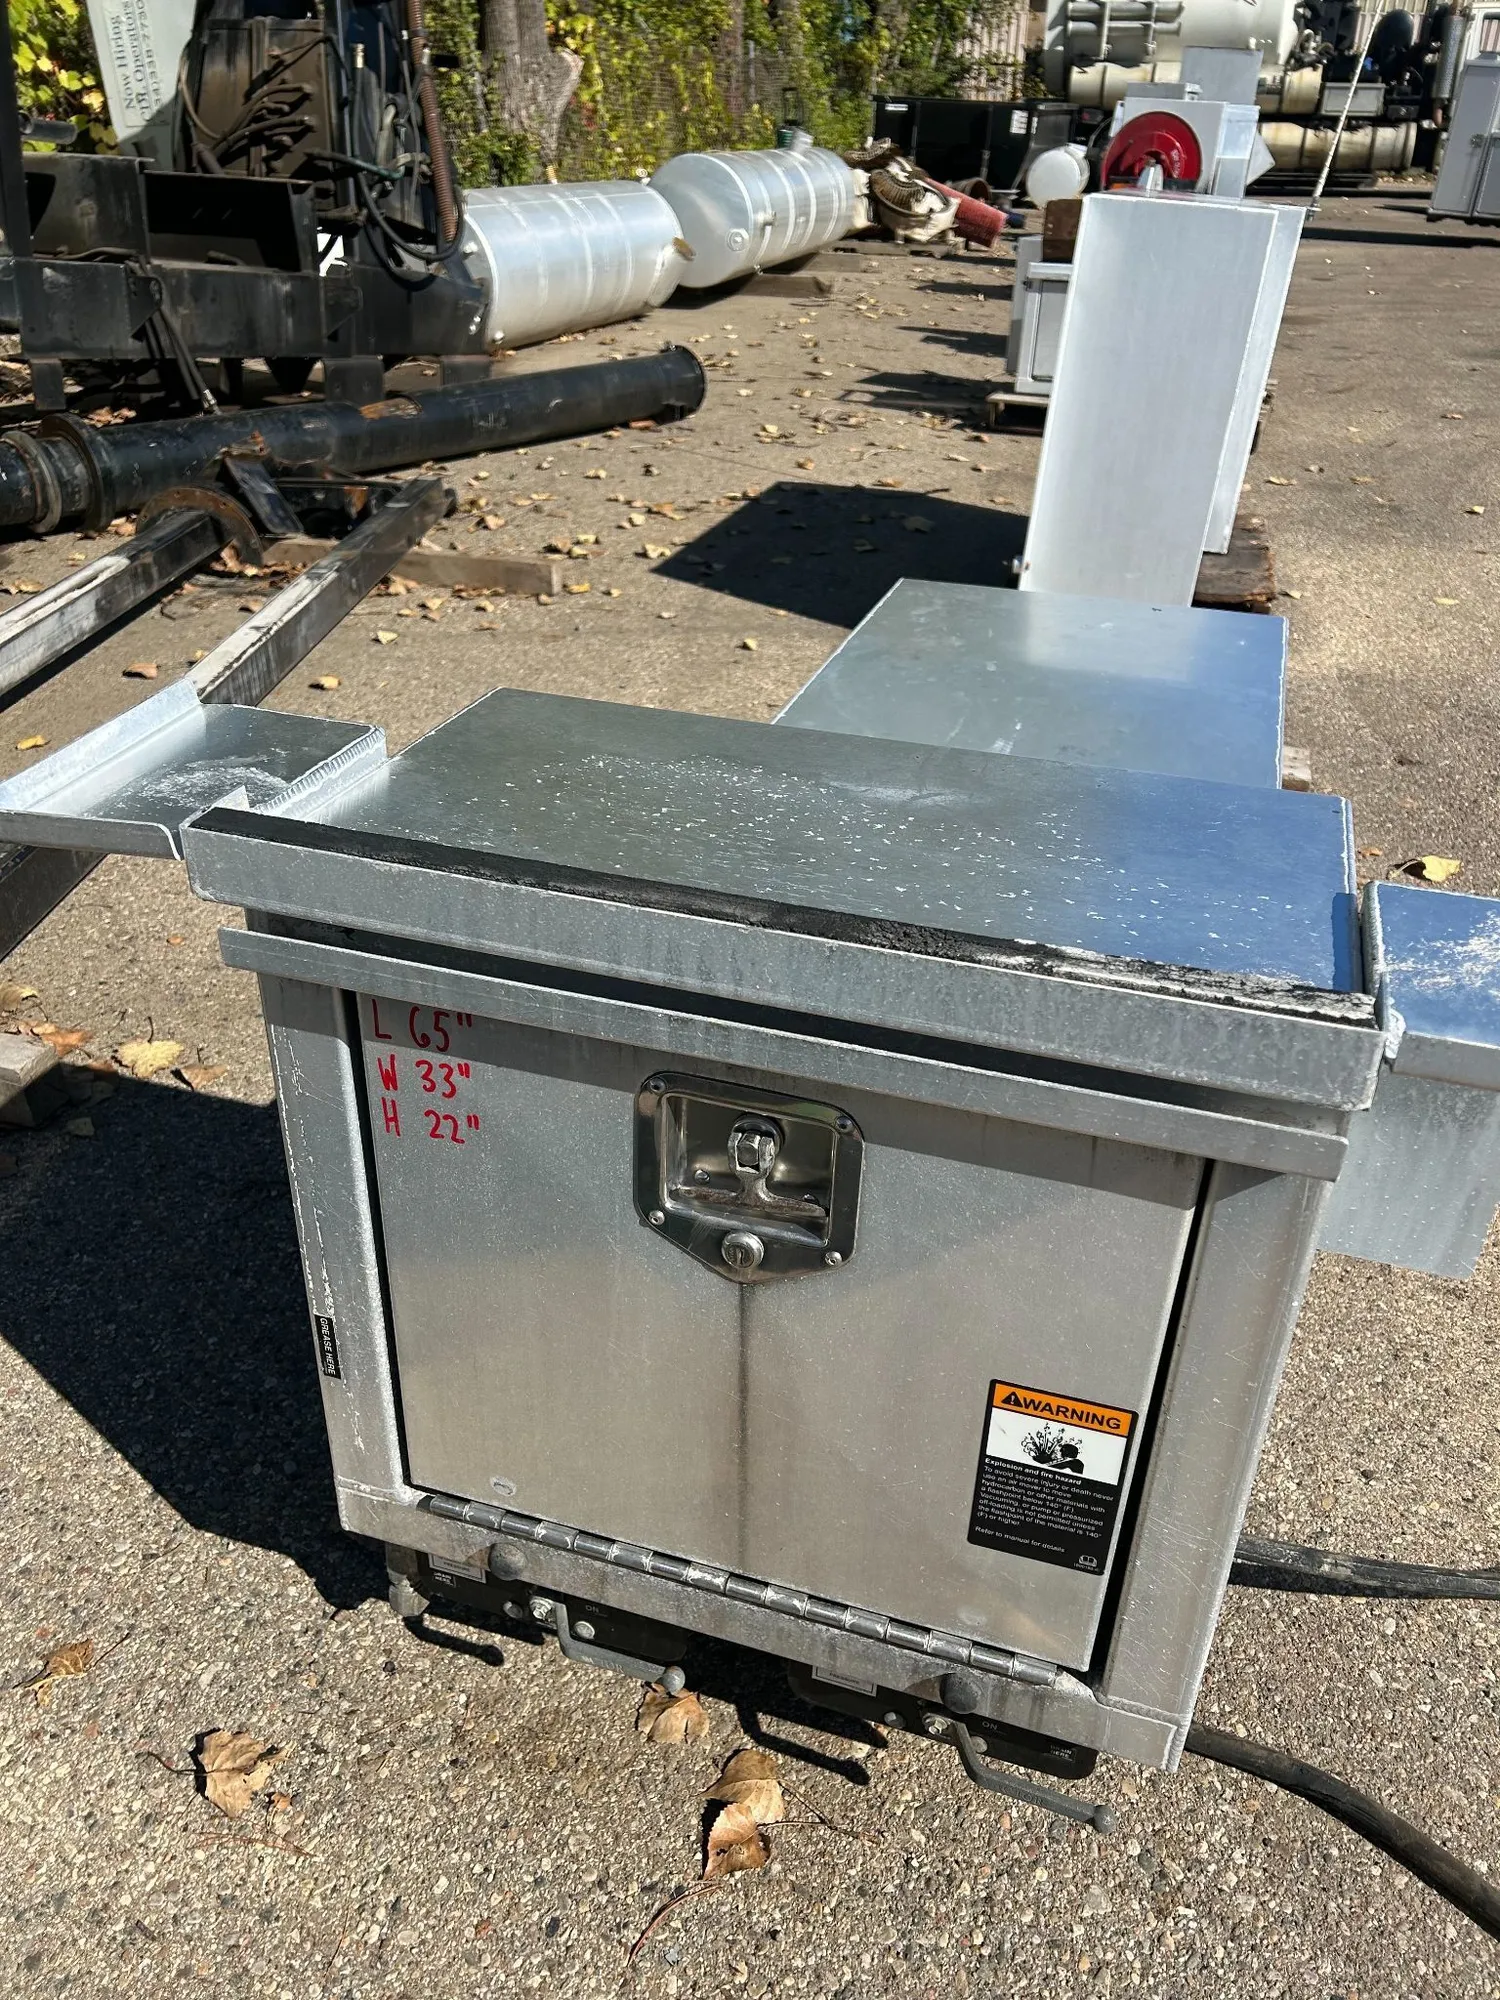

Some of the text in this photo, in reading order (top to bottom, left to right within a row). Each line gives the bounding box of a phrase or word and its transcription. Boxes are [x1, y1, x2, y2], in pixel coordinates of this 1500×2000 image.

[122, 74, 136, 109] Now
[371, 998, 473, 1053] L 65"
[377, 1054, 471, 1099] W 33"
[381, 1097, 480, 1144] H 22"
[320, 1317, 335, 1375] GREASE HERE
[1021, 1397, 1120, 1428] WARNING
[984, 1457, 1022, 1471] Explosion
[1055, 1474, 1081, 1485] hazard
[994, 1469, 1013, 1477] avoid
[1015, 1474, 1038, 1483] severe
[1070, 1487, 1091, 1495] death
[1022, 1495, 1043, 1505] below
[1030, 1505, 1051, 1514] pump
[1035, 1492, 1054, 1500] other
[975, 1526, 994, 1534] Refer
[1004, 1534, 1029, 1543] manual
[981, 1721, 998, 1731] ON
